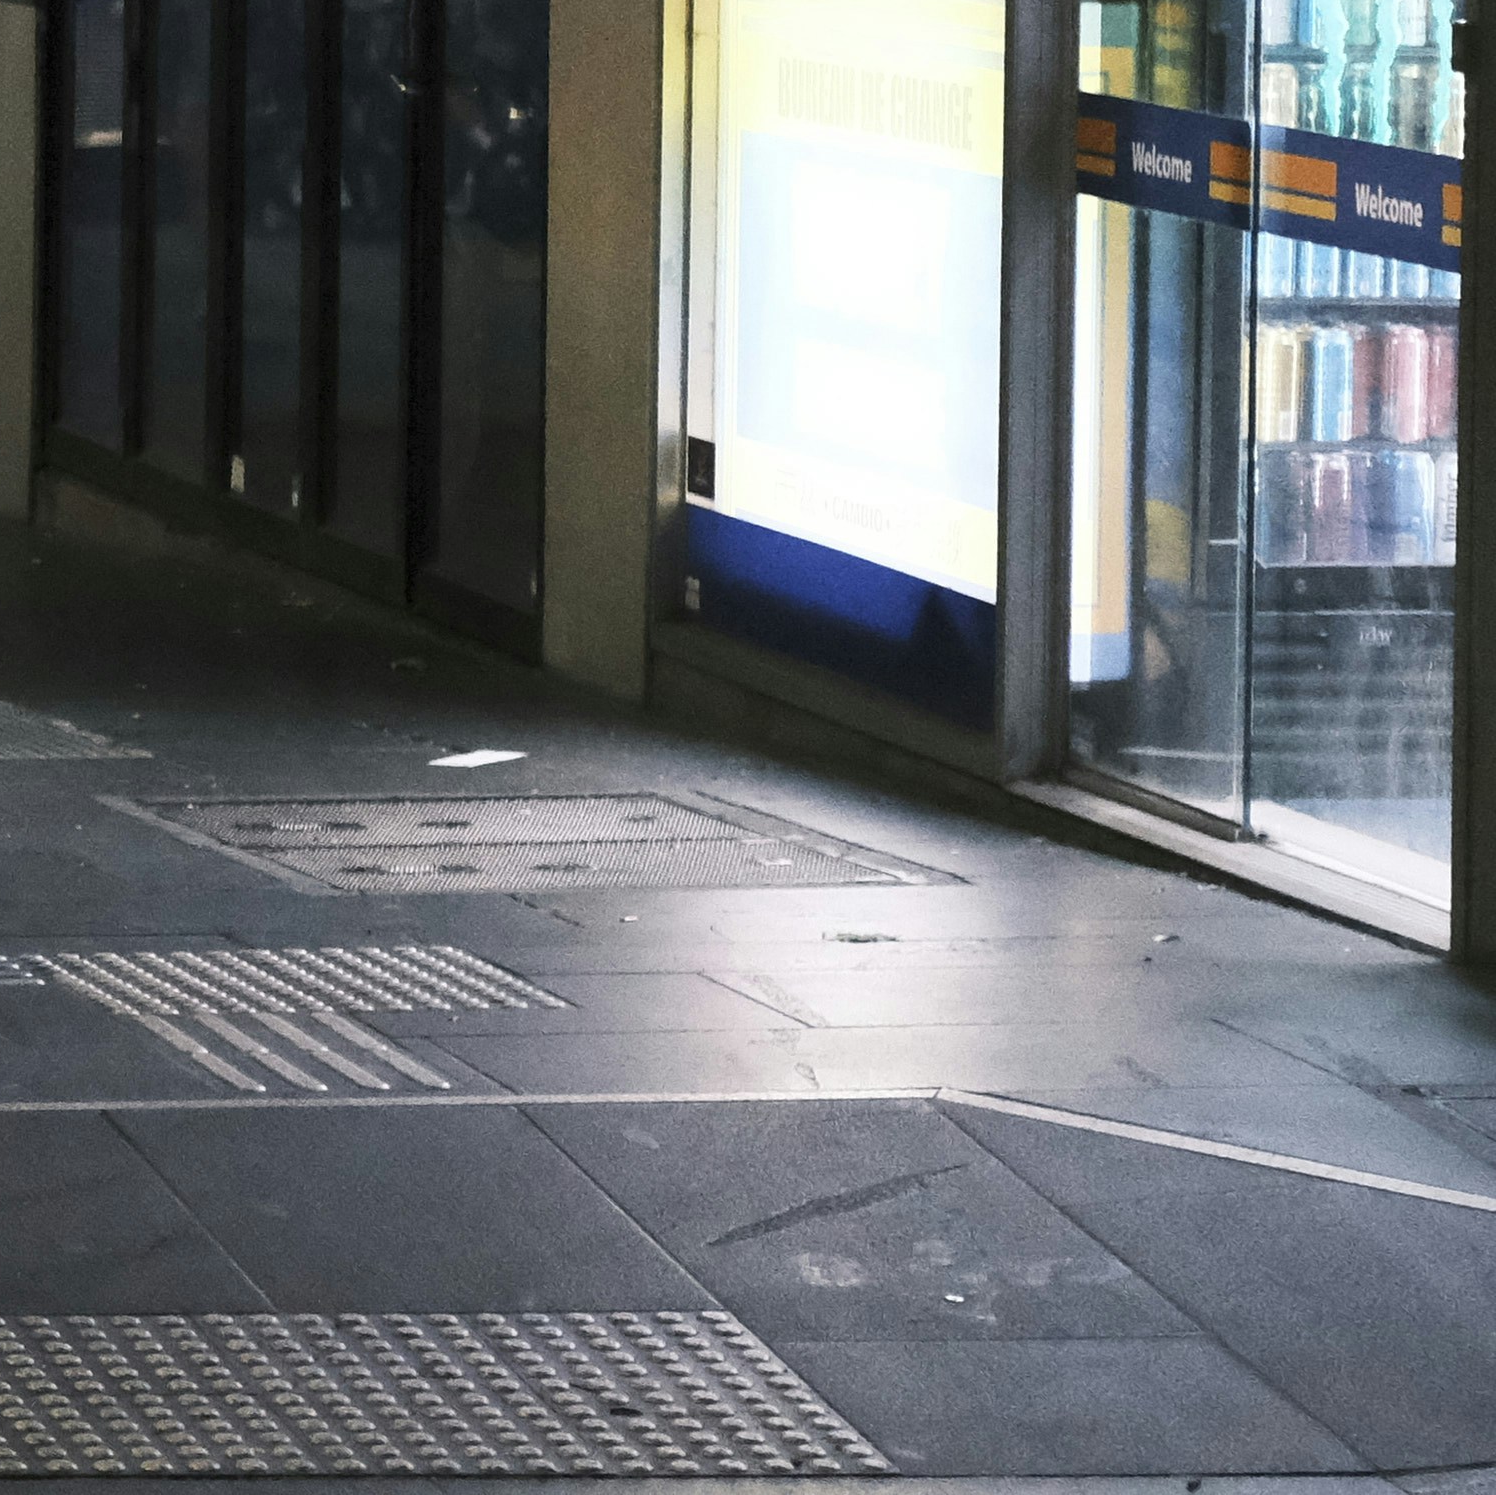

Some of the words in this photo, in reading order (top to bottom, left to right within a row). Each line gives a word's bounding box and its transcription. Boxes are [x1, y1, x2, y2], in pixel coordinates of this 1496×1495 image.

[778, 55, 857, 130] BUREAU
[859, 67, 886, 136] DE
[889, 72, 975, 153] CHANGE
[1131, 140, 1193, 184] Welcome
[1354, 183, 1424, 228] Welcome
